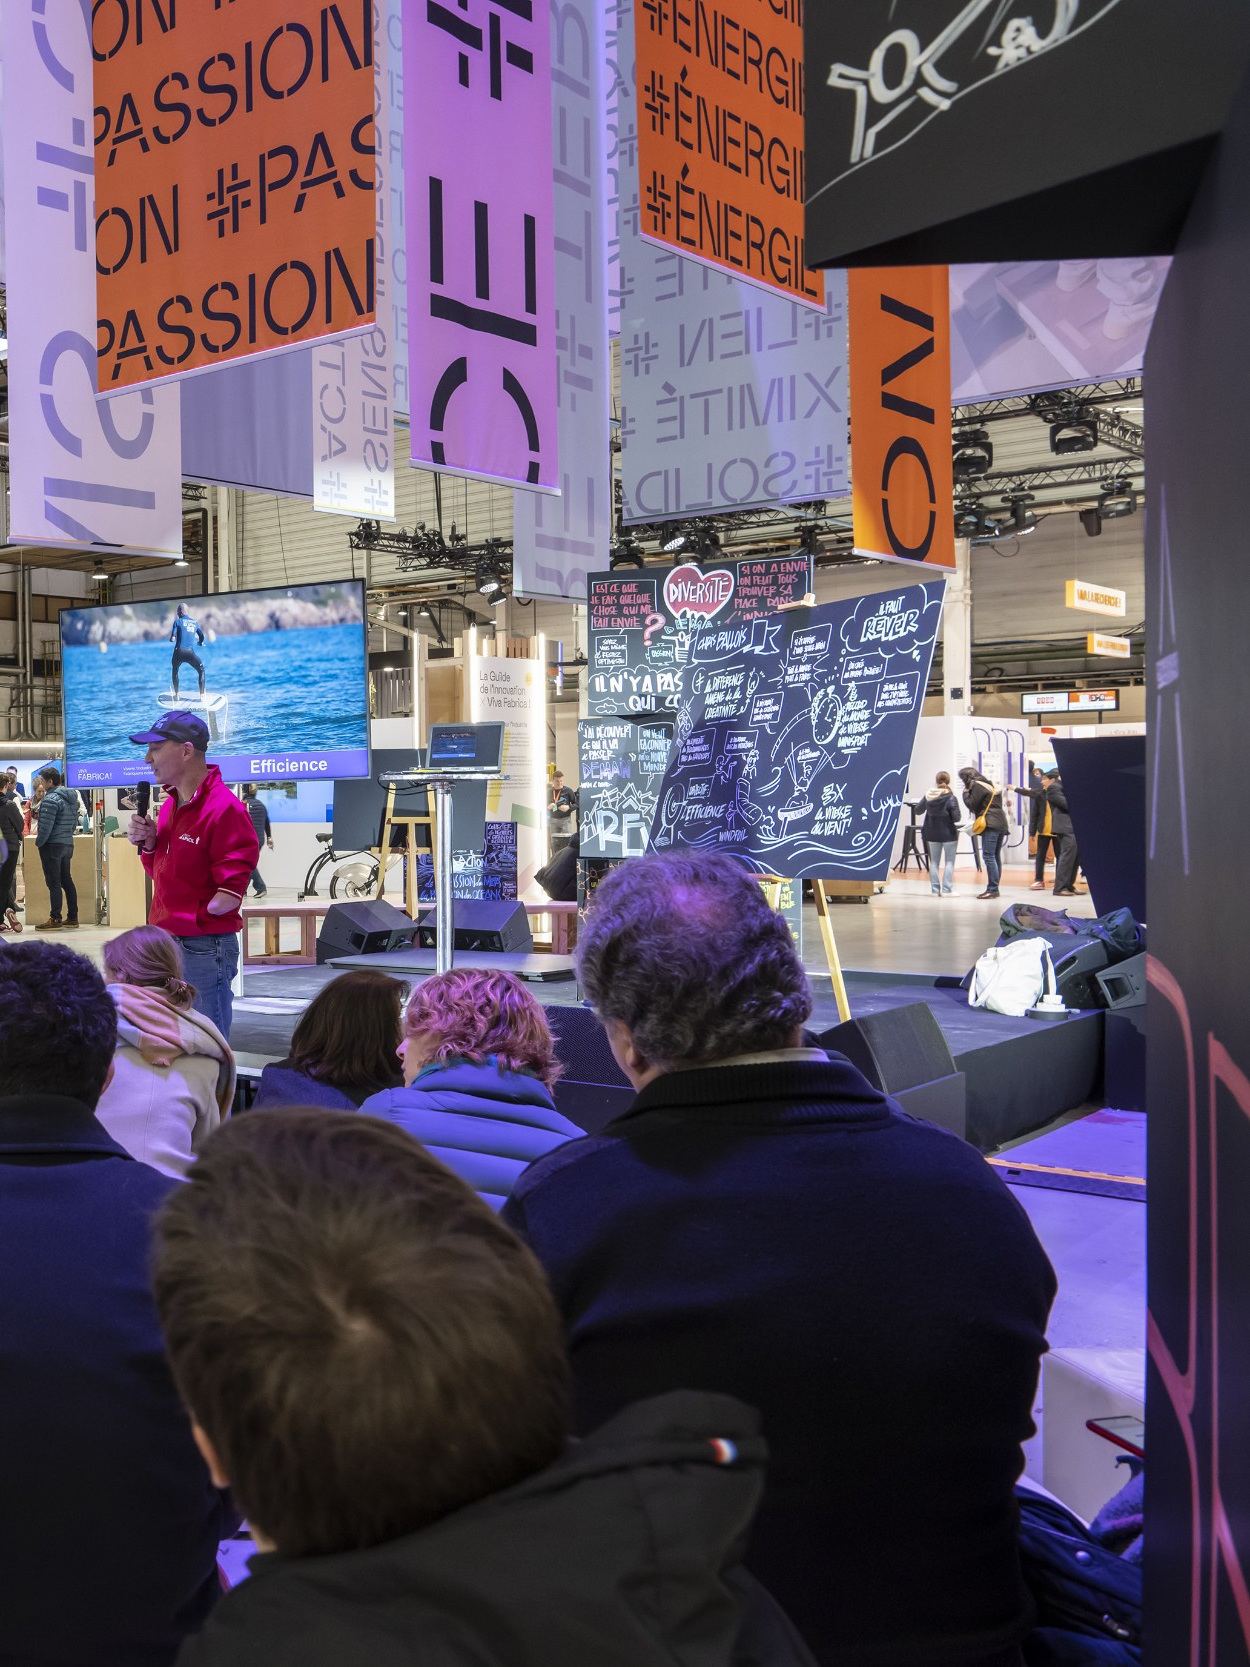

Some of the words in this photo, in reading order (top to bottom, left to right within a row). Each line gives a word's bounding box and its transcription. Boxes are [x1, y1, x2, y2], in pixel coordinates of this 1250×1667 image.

[644, 64, 805, 204] #ÉNERGI
[781, 561, 809, 572] ENVIE
[669, 577, 730, 604] DIVERSITÉ
[479, 671, 488, 682] La
[480, 684, 489, 694] de
[250, 758, 328, 775] Efficience
